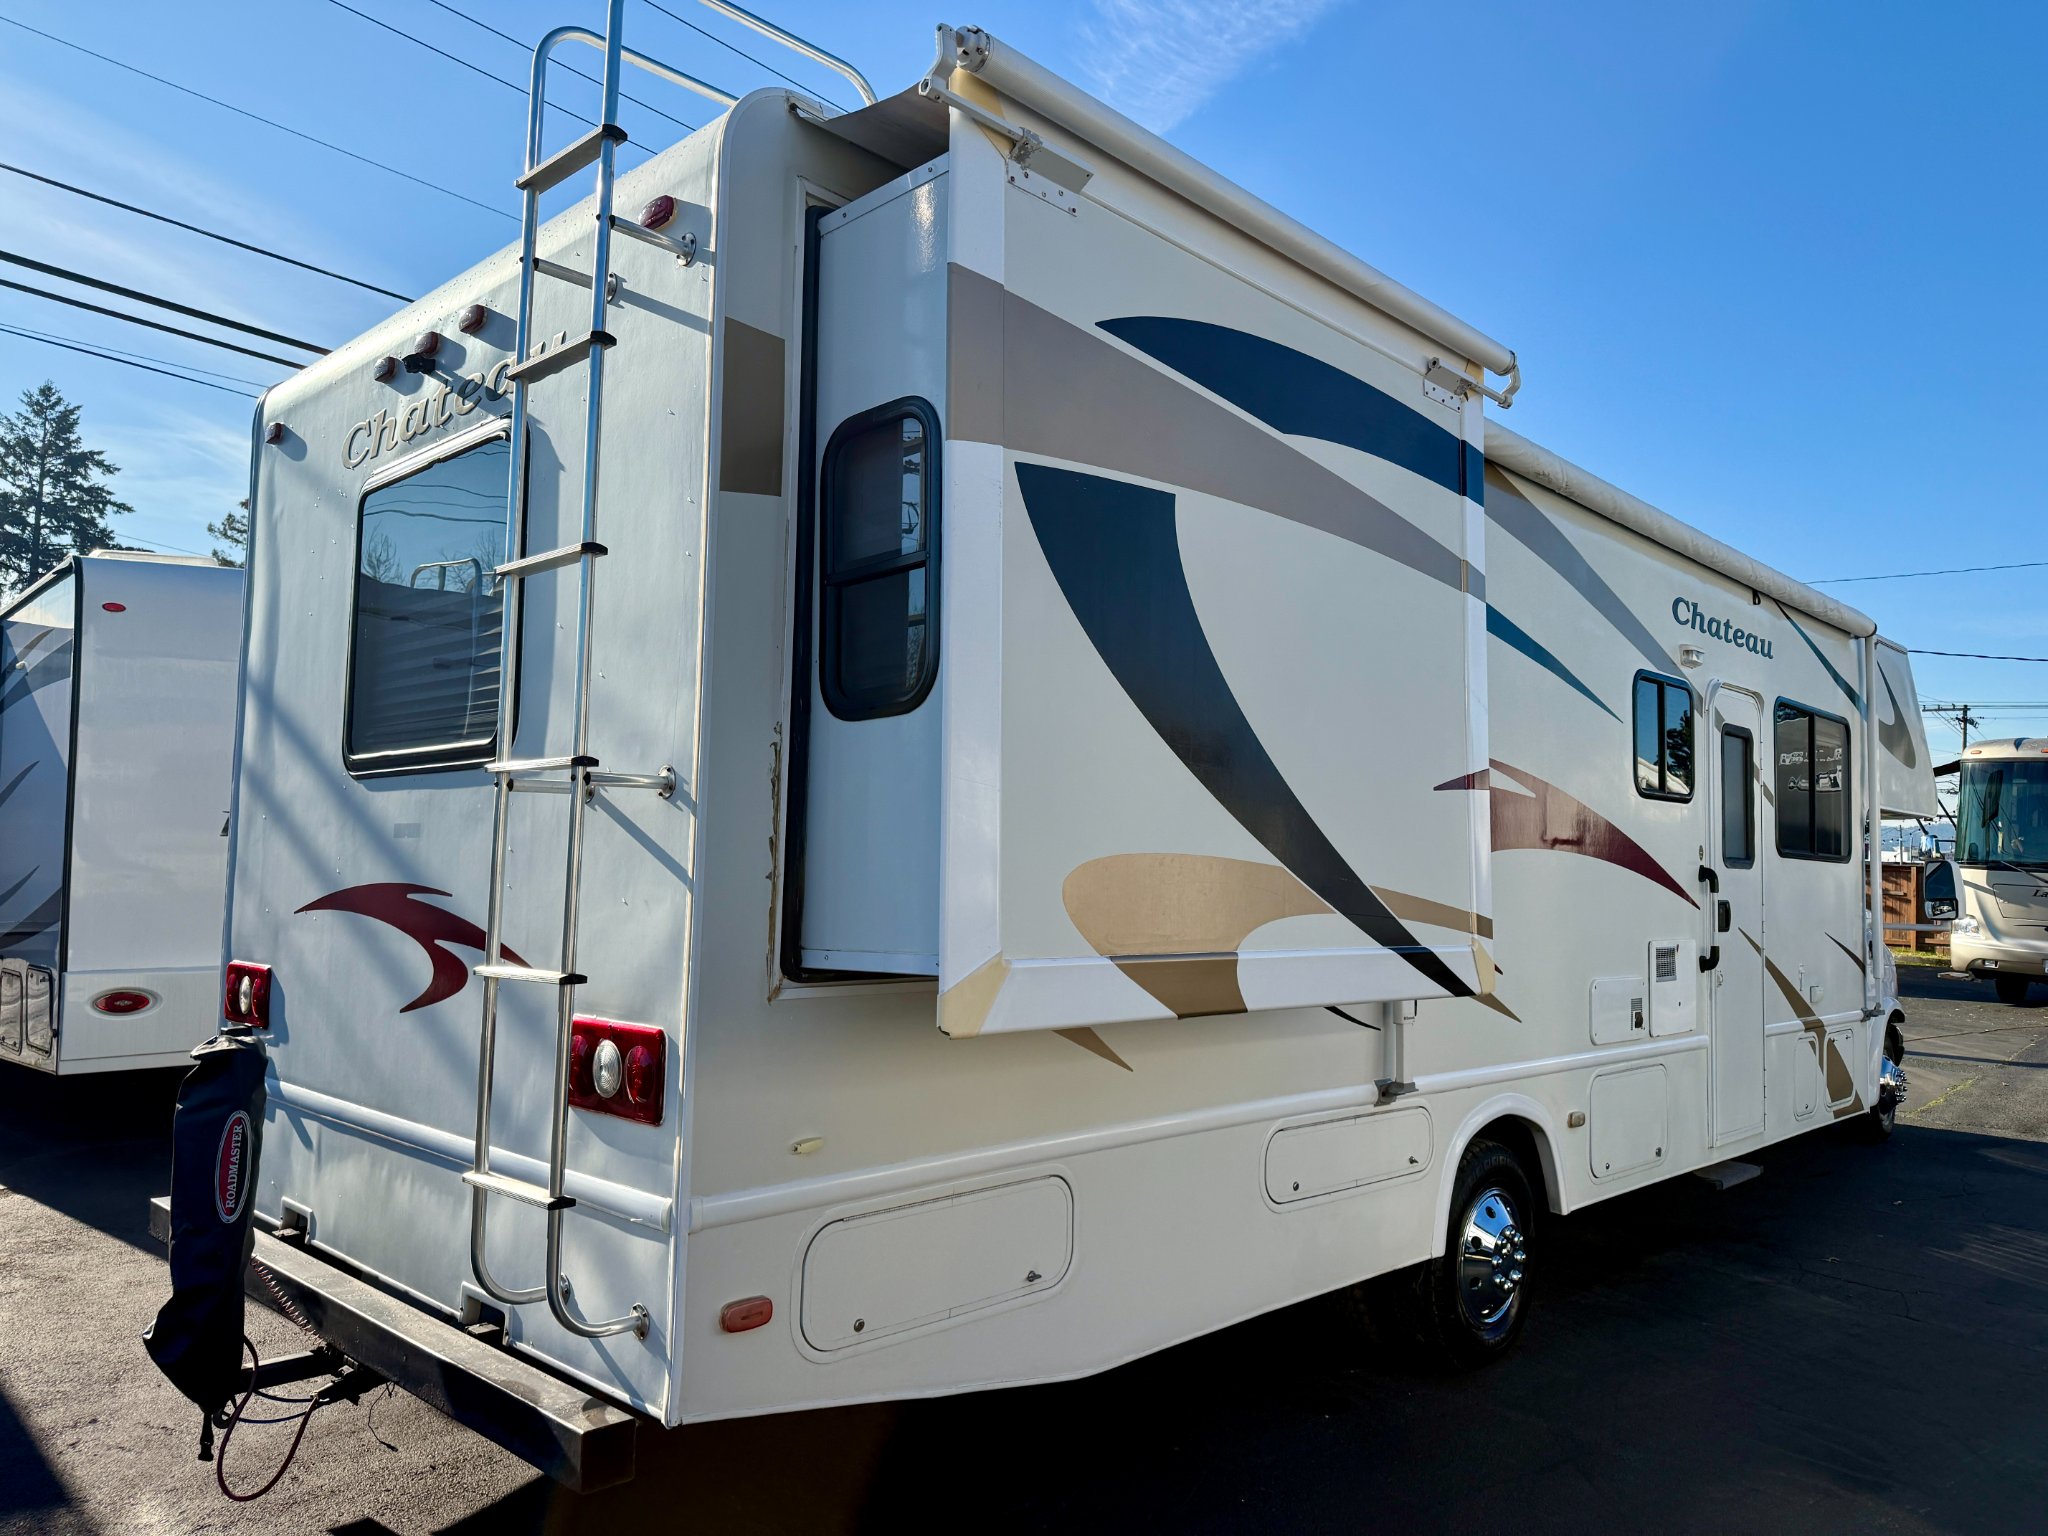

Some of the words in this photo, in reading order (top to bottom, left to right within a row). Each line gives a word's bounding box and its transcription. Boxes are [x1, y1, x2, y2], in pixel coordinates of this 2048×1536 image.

[341, 331, 566, 470] Chatea
[1671, 596, 1774, 660] Chateau
[224, 1124, 244, 1209] ROADMASTER
